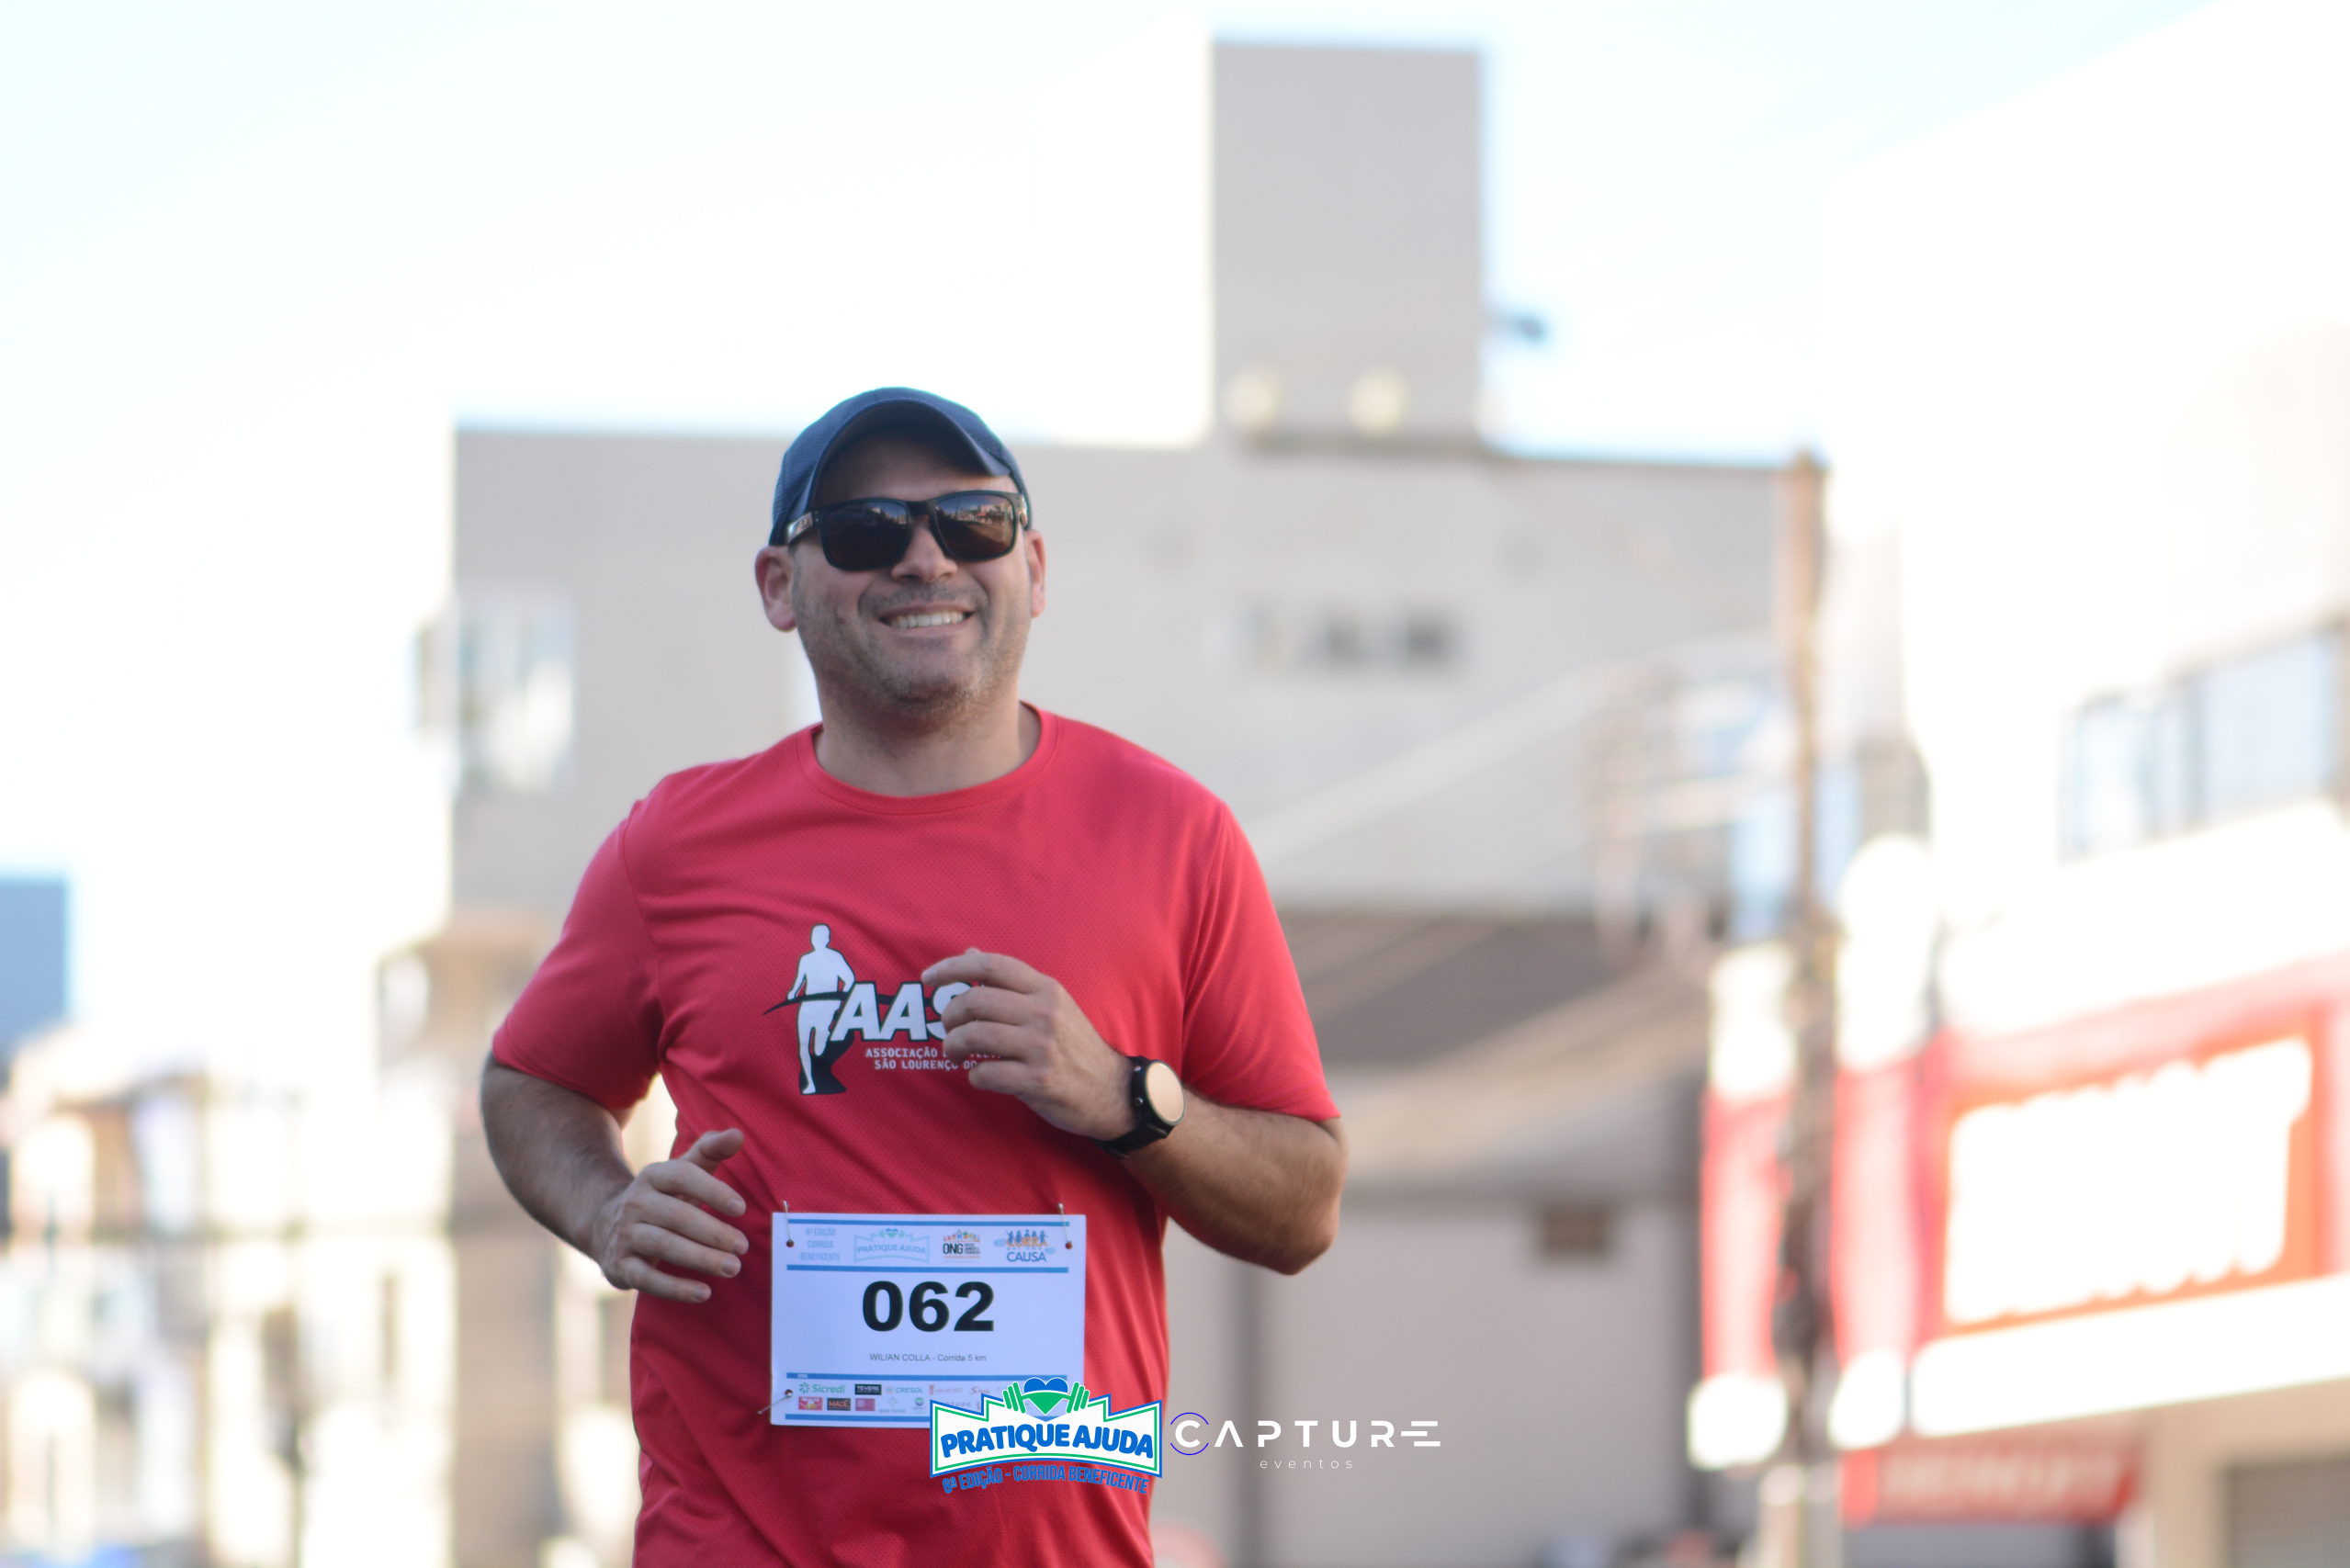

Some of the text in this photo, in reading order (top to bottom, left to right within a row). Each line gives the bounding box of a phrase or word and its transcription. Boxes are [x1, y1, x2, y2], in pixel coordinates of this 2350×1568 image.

[865, 1046, 938, 1059] ASSOCIAÇÃO
[875, 1058, 897, 1069] SÃO
[814, 1227, 836, 1237] EDIÇÃO
[808, 1240, 834, 1249] CORRIDA
[857, 1244, 926, 1255] PRATIQUE AJUDA
[943, 1243, 964, 1255] ONG
[800, 1252, 841, 1261] BENEFICENTE
[1006, 1252, 1047, 1262] CAUSA
[862, 1280, 995, 1333] 062
[812, 1383, 846, 1393] Sicredi
